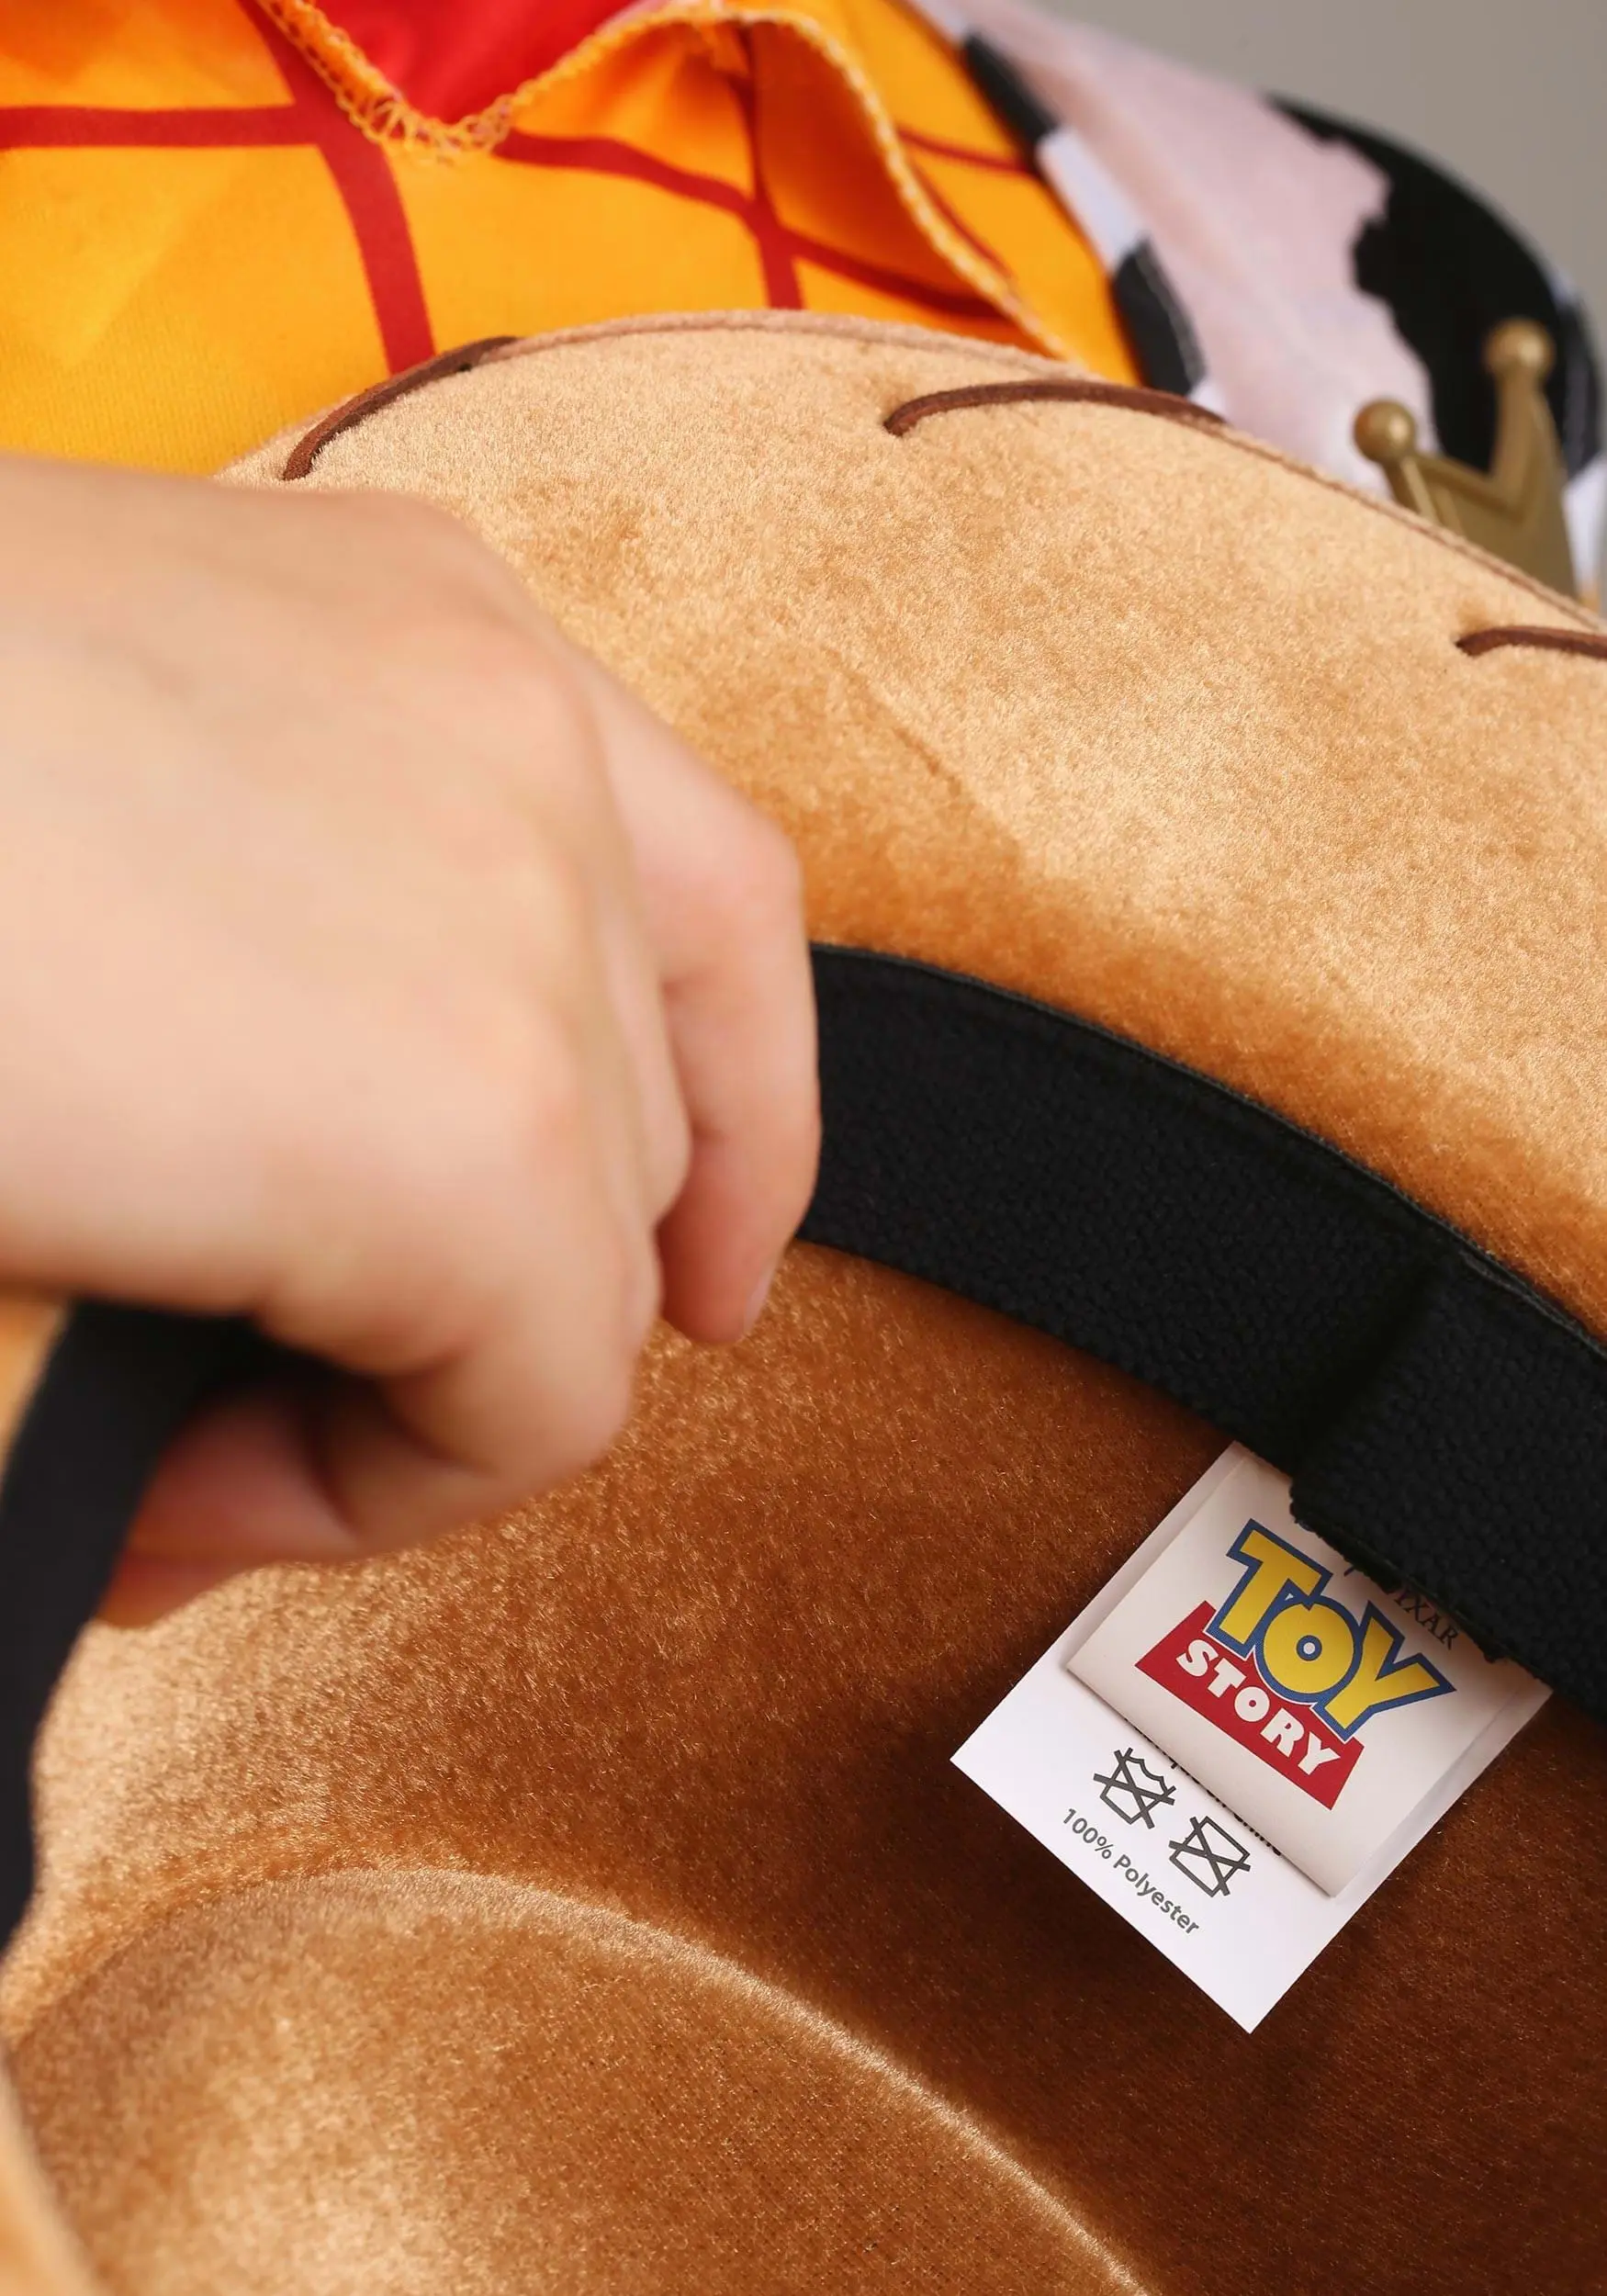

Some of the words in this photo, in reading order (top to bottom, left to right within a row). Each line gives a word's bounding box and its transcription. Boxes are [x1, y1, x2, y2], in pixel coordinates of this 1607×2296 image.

[1208, 1518, 1456, 1742] TOY
[1388, 1583, 1459, 1650] IXAR
[1175, 1639, 1341, 1775] STORY
[1062, 1807, 1114, 1860] 100%
[1113, 1854, 1199, 1934] Polyester
